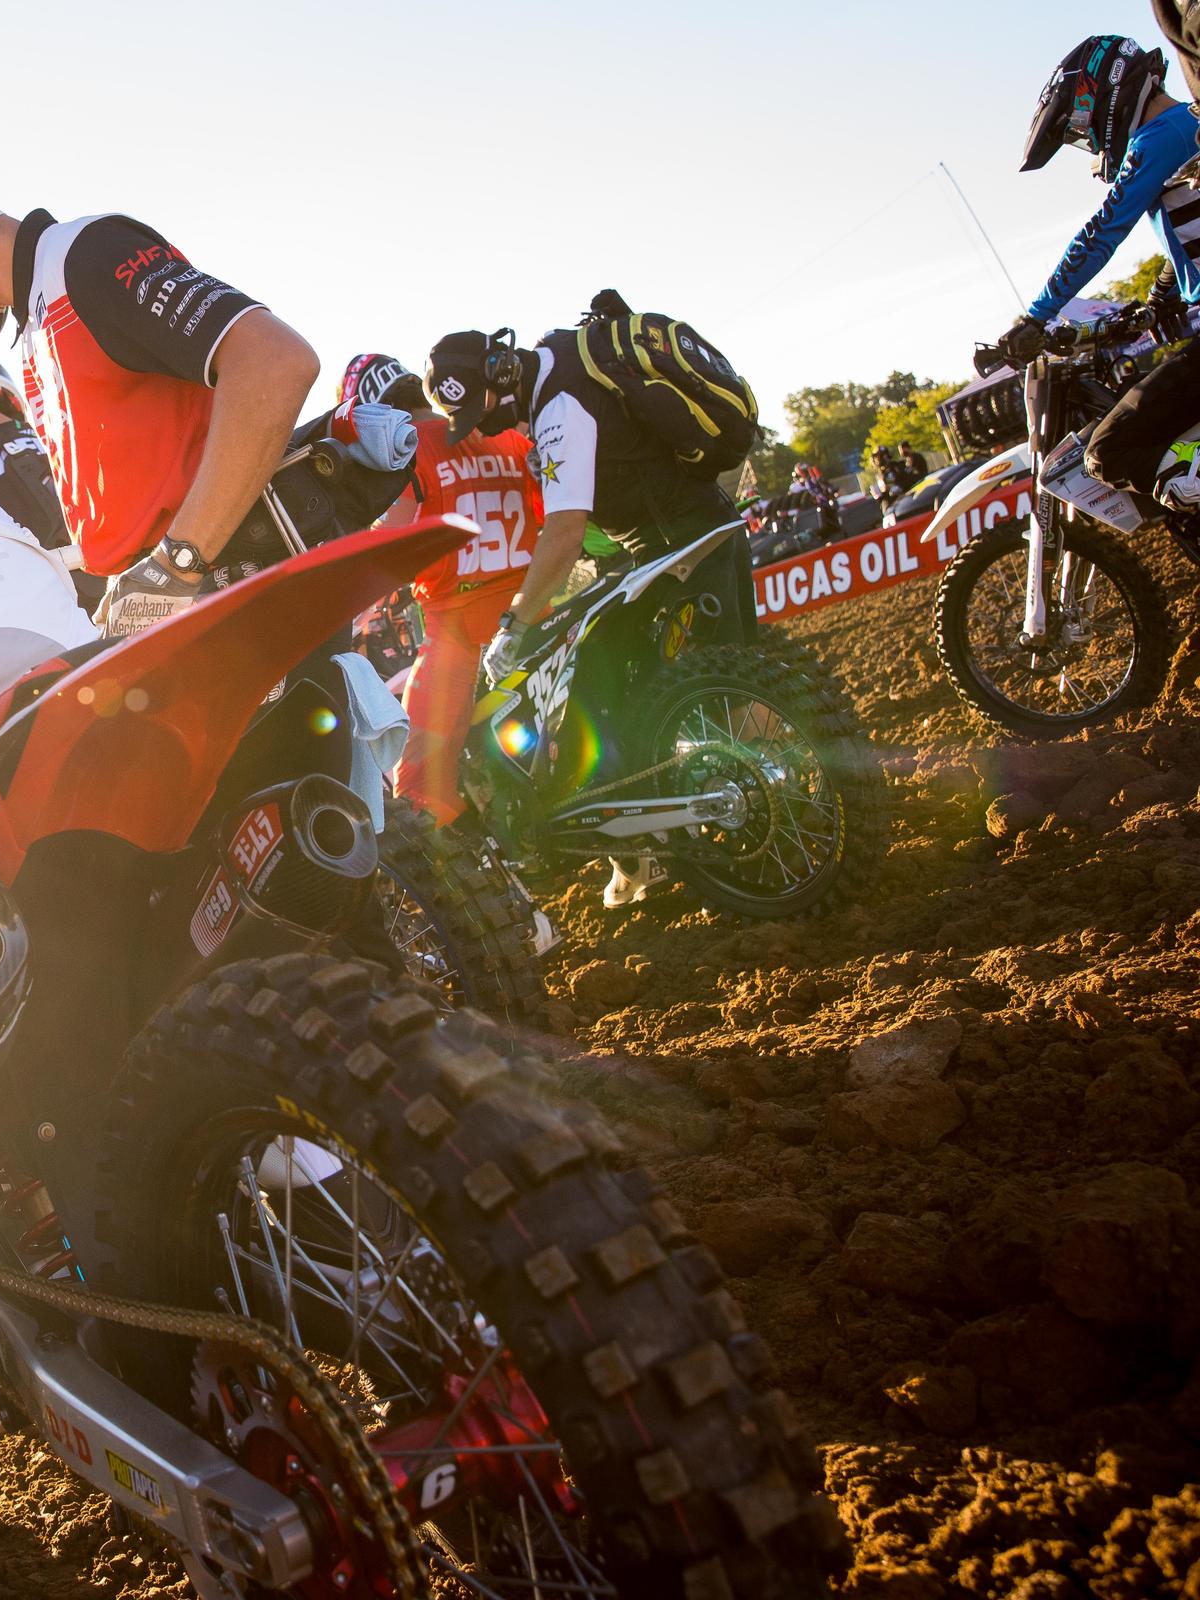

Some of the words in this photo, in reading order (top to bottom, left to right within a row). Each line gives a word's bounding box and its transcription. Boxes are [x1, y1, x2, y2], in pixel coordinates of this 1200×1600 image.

[1109, 85, 1120, 114] LENDING
[1105, 115, 1114, 141] STREET
[436, 455, 522, 487] SWOLL
[754, 551, 851, 617] LUCAS
[859, 532, 918, 583] OIL
[119, 596, 174, 619] Mechanix
[420, 1463, 457, 1509] 6
